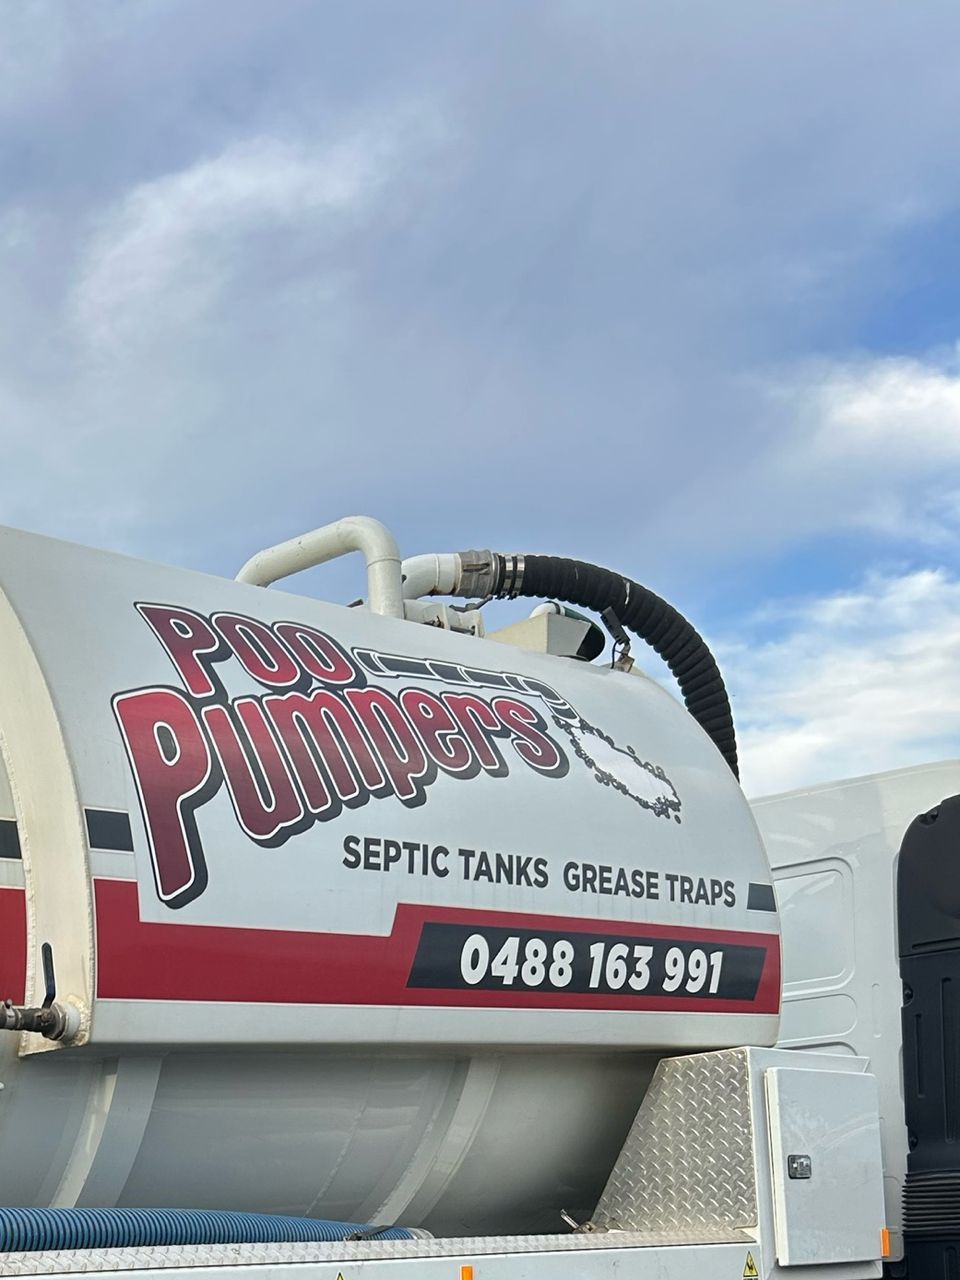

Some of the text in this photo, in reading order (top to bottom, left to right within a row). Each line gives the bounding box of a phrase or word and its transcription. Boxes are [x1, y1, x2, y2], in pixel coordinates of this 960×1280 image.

[343, 836, 736, 907] SEPTIC TANKS GREASE TRAPS
[460, 933, 724, 994] 0488 163 991
